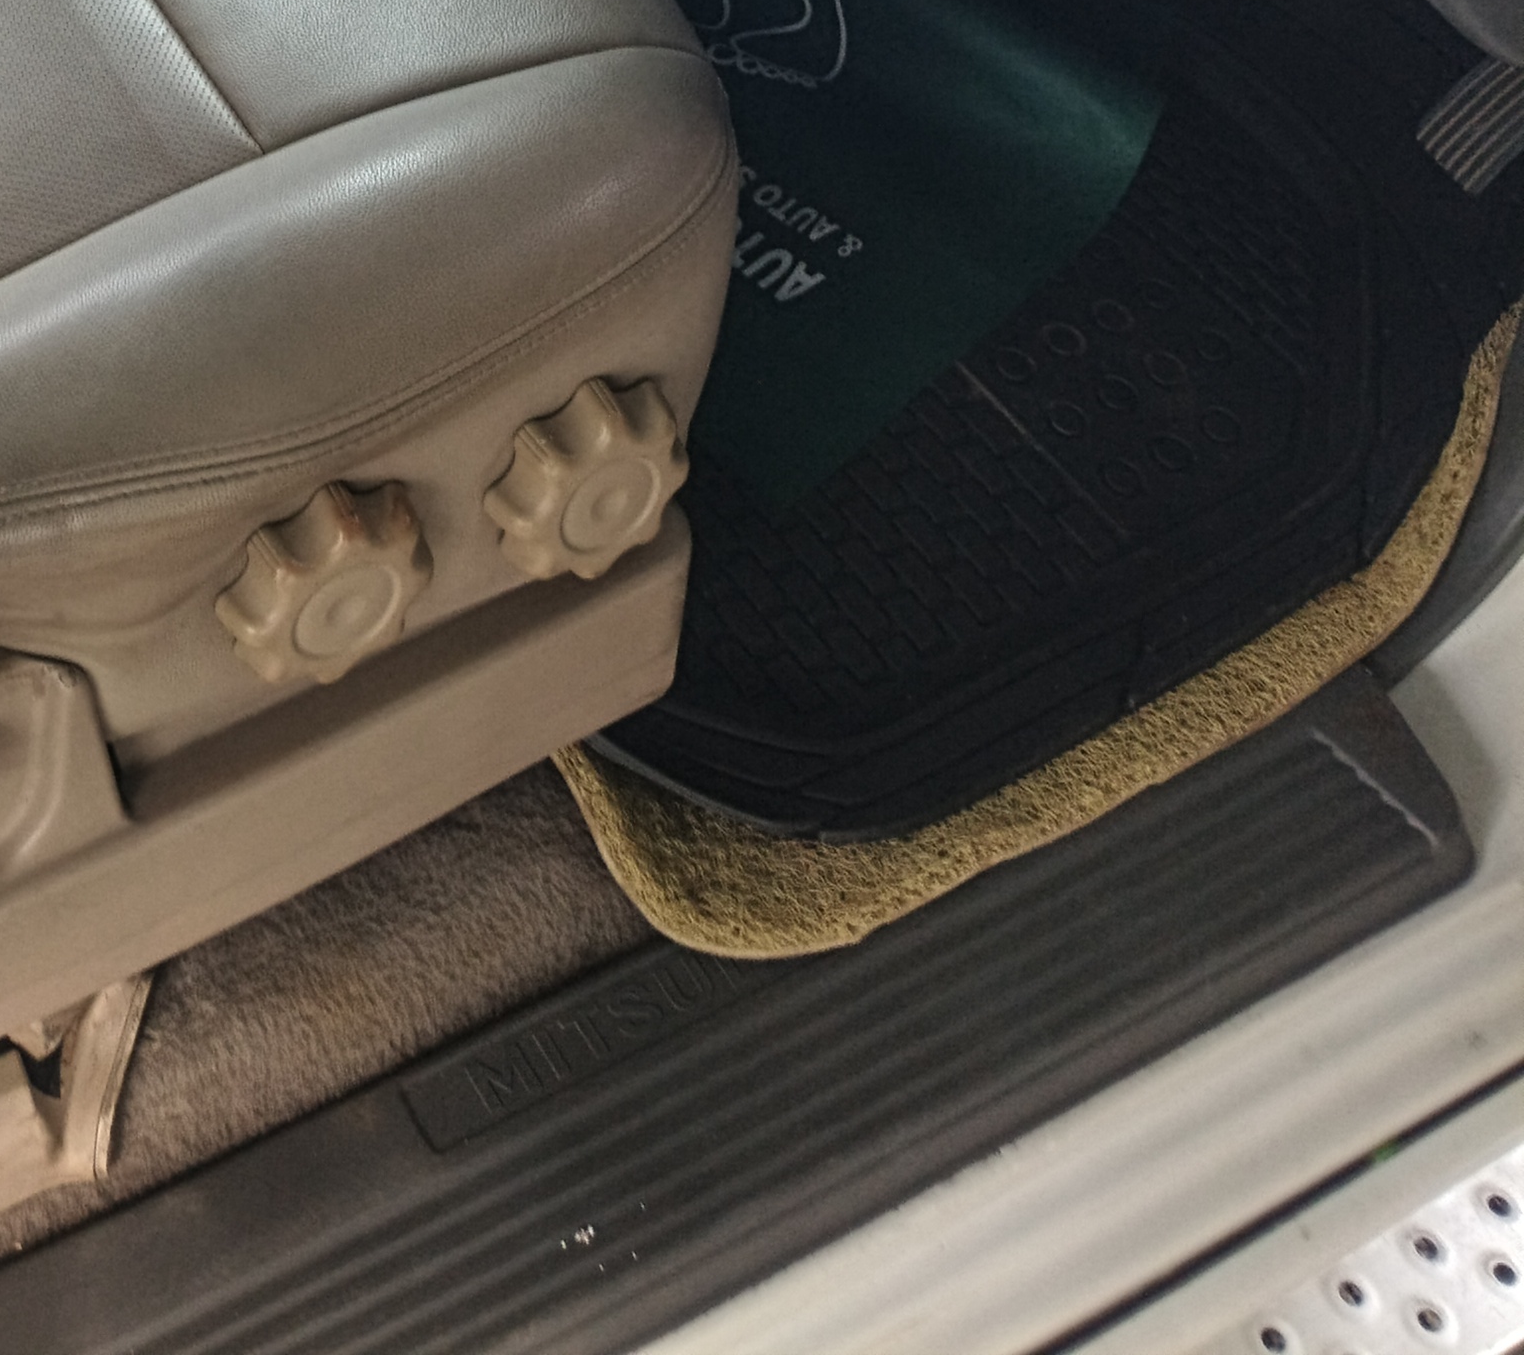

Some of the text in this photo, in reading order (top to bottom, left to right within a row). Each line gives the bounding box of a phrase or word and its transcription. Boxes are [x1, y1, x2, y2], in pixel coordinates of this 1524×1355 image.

[752, 183, 841, 243] AUTO
[731, 219, 827, 302] AUT
[836, 232, 864, 258] &
